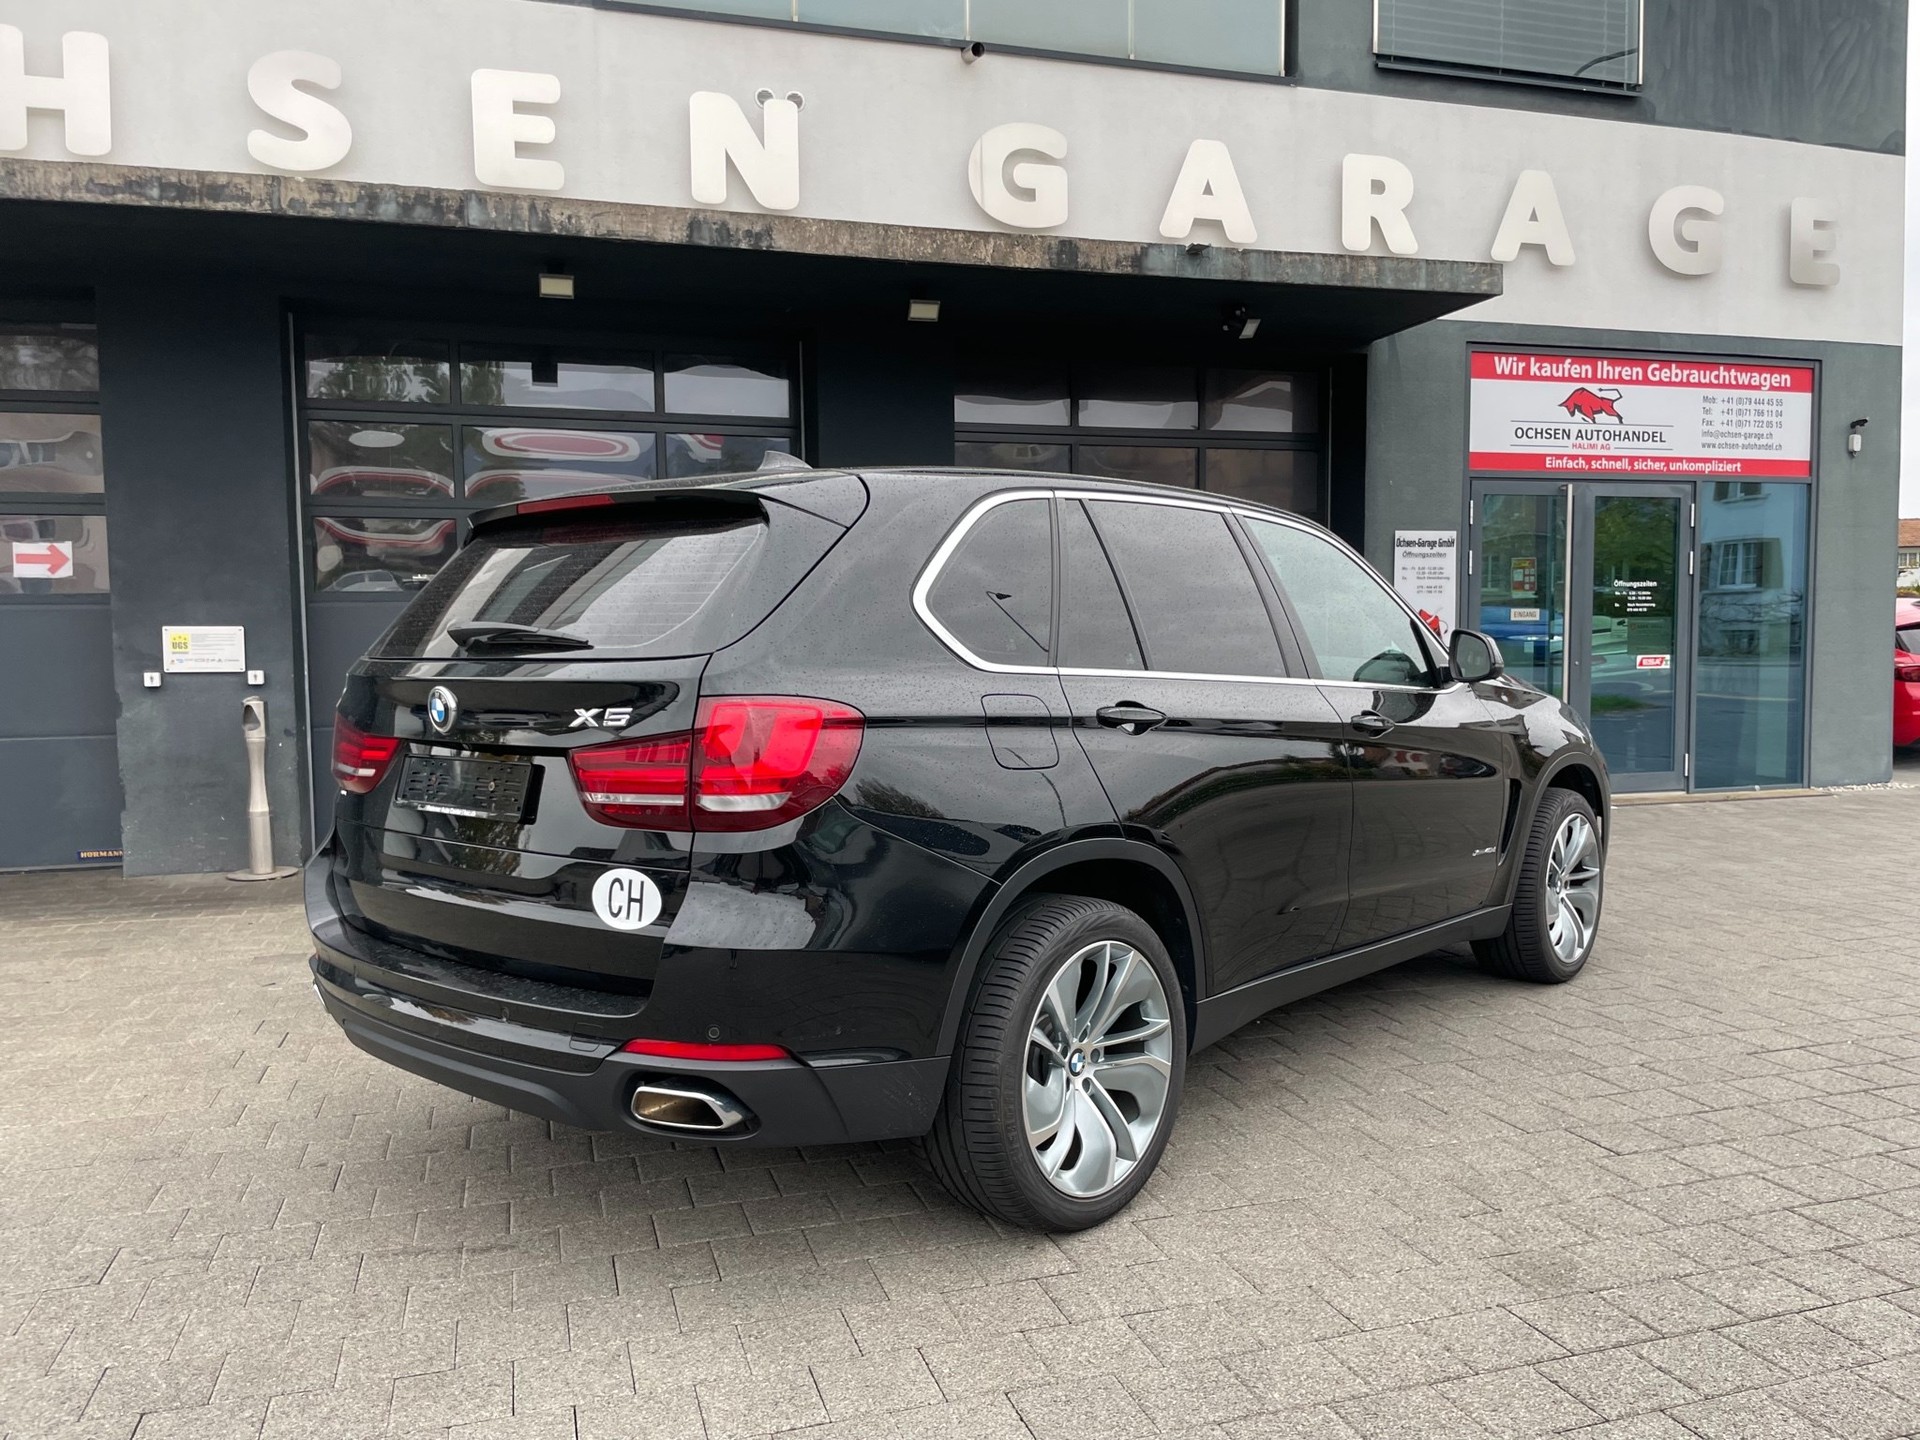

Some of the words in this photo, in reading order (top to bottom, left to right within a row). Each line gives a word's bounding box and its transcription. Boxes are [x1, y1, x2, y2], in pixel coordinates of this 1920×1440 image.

[968, 122, 1841, 286] GARAGE
[1494, 356, 1525, 376] Wir
[1530, 357, 1592, 379] kaufen
[1597, 360, 1642, 381] Ihren
[1647, 363, 1791, 390] Gebrauchtwagen
[1702, 395, 1718, 404] Mob:
[1721, 397, 1734, 405] +41
[1735, 397, 1752, 406] (0)79
[1753, 398, 1765, 406] 444
[1766, 398, 1774, 407] 45
[1702, 407, 1713, 415] Tel:
[1721, 408, 1734, 416] +41
[1735, 408, 1751, 417] (0)71
[1766, 409, 1773, 417] 11
[1775, 409, 1783, 418] 04
[1702, 418, 1715, 426] Fax:
[1720, 419, 1733, 427] +41
[1735, 419, 1751, 428] (0)71
[1753, 420, 1764, 428] 722
[1775, 421, 1783, 429] 15
[1514, 426, 1571, 440] OCHSEN
[1575, 428, 1666, 443] AUTOHANDEL
[1701, 429, 1773, 440] info@ochsen-garage.ch
[1572, 442, 1598, 450] HALIMI
[1600, 443, 1611, 451] AG
[1701, 442, 1783, 451] www.ochsen-autohandel.ch
[1545, 456, 1589, 470] Einfach,
[1591, 458, 1631, 471] schnell,
[1633, 459, 1667, 472] sicher,
[1669, 460, 1742, 474] unkompliziert
[1513, 610, 1537, 618] EINGANG
[568, 707, 633, 728] X5
[607, 877, 645, 922] CH
